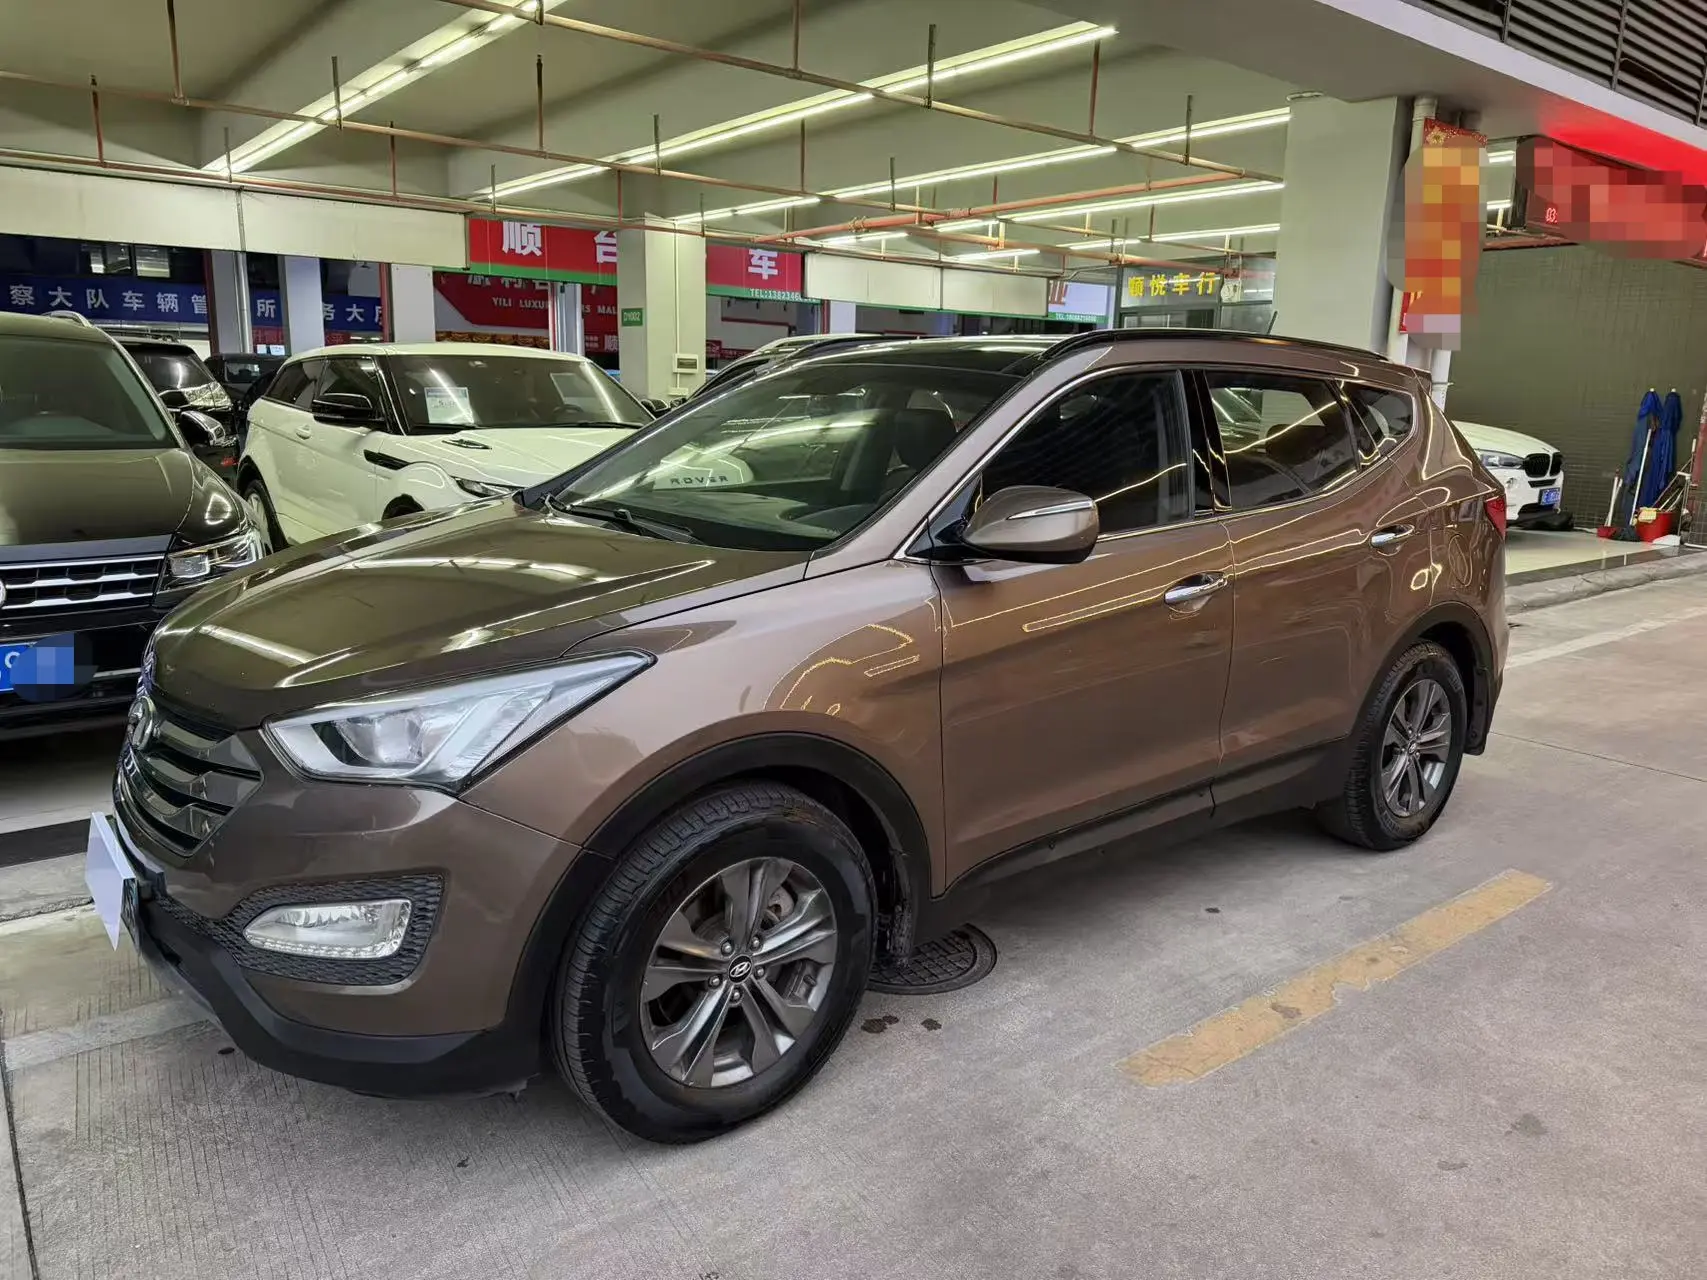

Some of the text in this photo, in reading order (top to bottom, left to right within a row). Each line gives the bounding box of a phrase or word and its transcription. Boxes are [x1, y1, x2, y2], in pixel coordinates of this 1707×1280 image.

[748, 248, 779, 280] 车
[256, 299, 277, 318] 所
[670, 475, 729, 485] ROVER
